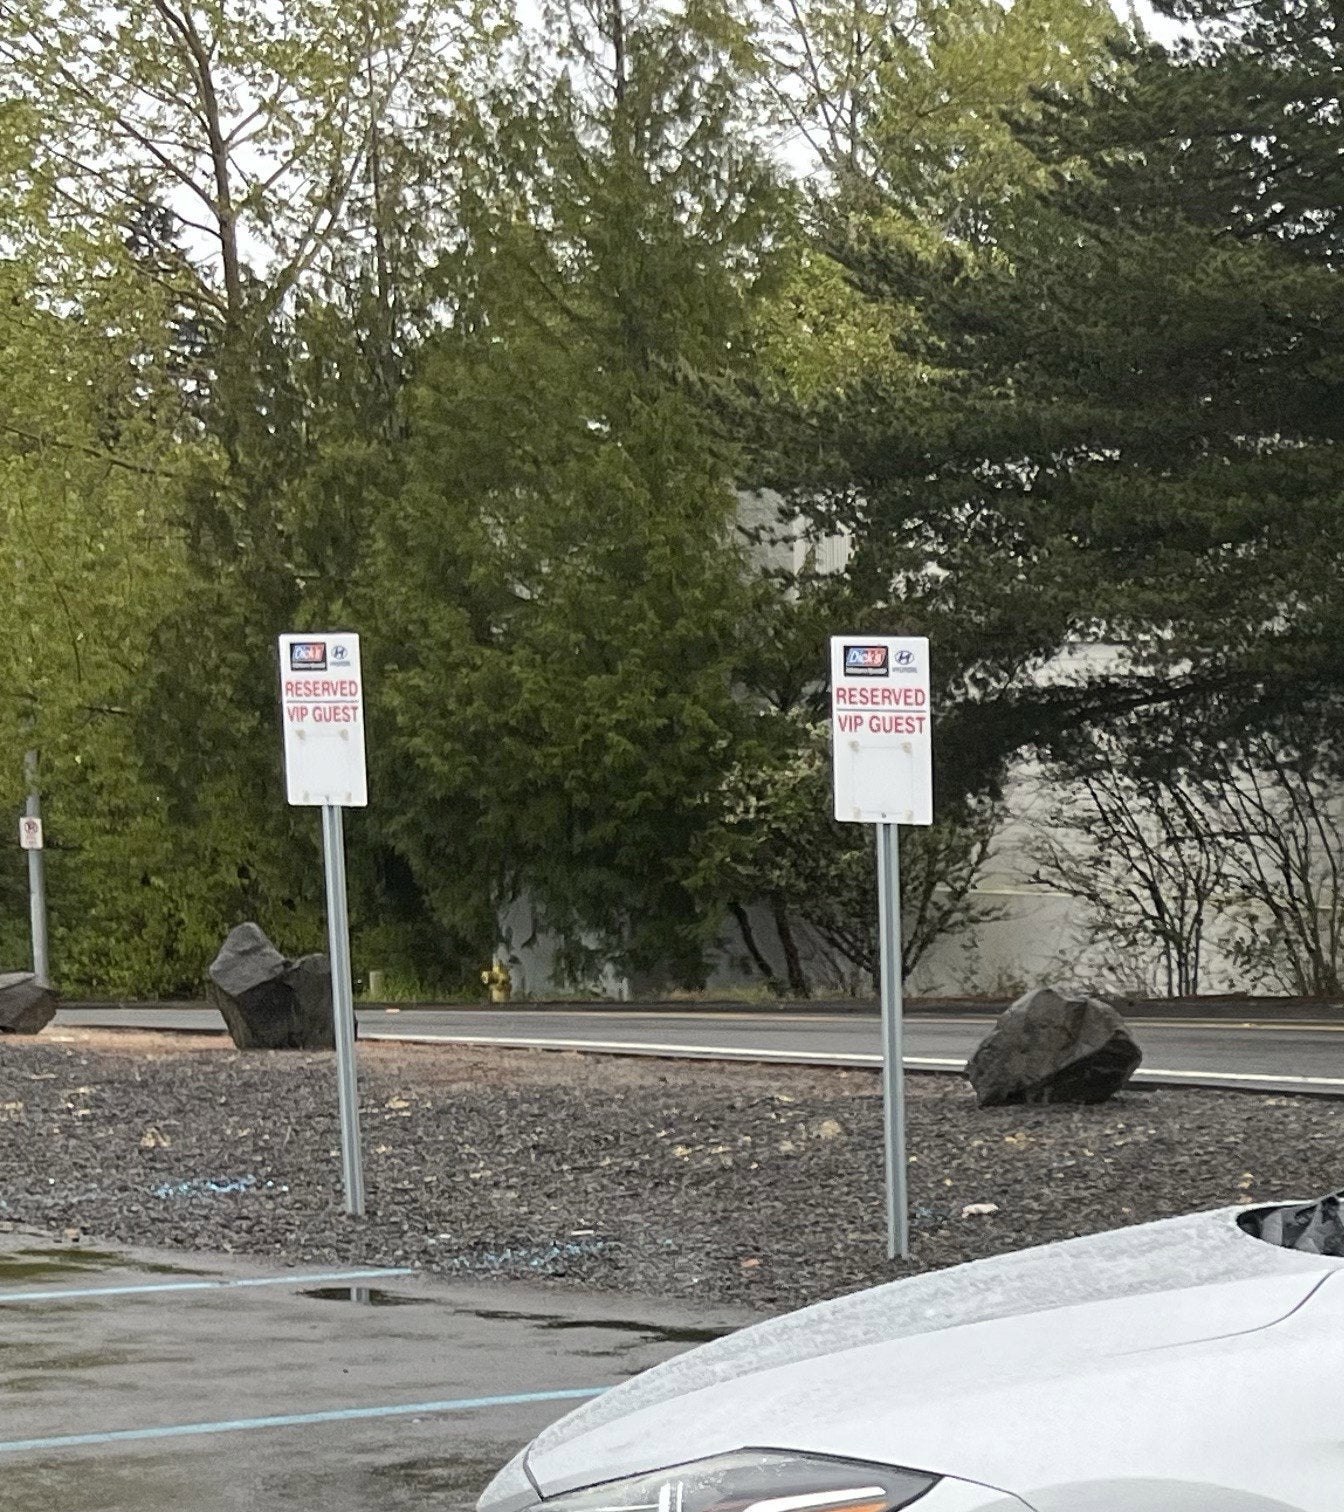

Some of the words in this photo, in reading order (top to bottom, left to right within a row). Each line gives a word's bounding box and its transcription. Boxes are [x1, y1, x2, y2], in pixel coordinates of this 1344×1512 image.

[285, 680, 358, 698] RESERVED
[836, 687, 926, 707] RESERVED
[287, 706, 309, 723] VIP
[312, 706, 359, 723] GUEST
[838, 715, 864, 733] VIP
[869, 715, 926, 735] GUEST
